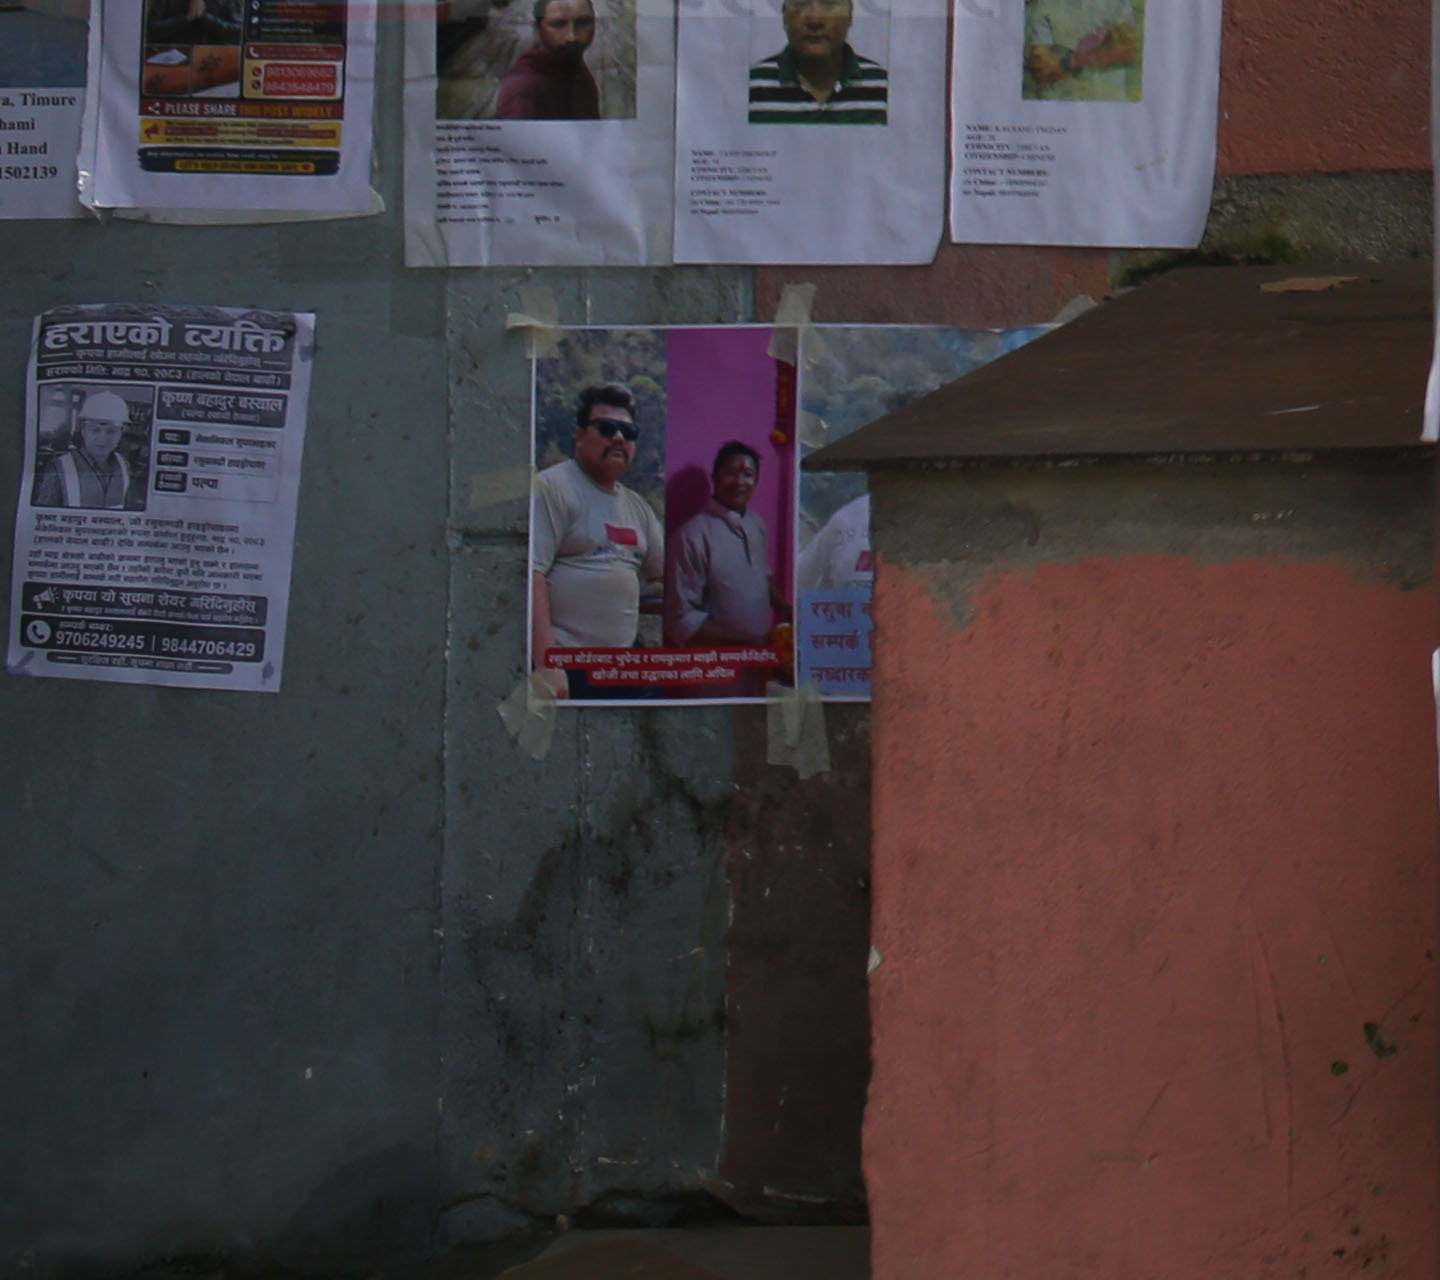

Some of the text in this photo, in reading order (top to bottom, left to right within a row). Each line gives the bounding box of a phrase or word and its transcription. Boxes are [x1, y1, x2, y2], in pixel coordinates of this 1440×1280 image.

[21, 94, 76, 107] Timure
[165, 103, 237, 116] PLEASE SHARE
[6, 143, 48, 155] Hand
[44, 316, 286, 353] हराएको व्यक्ति
[56, 630, 255, 657] 9706249245 9844706429
